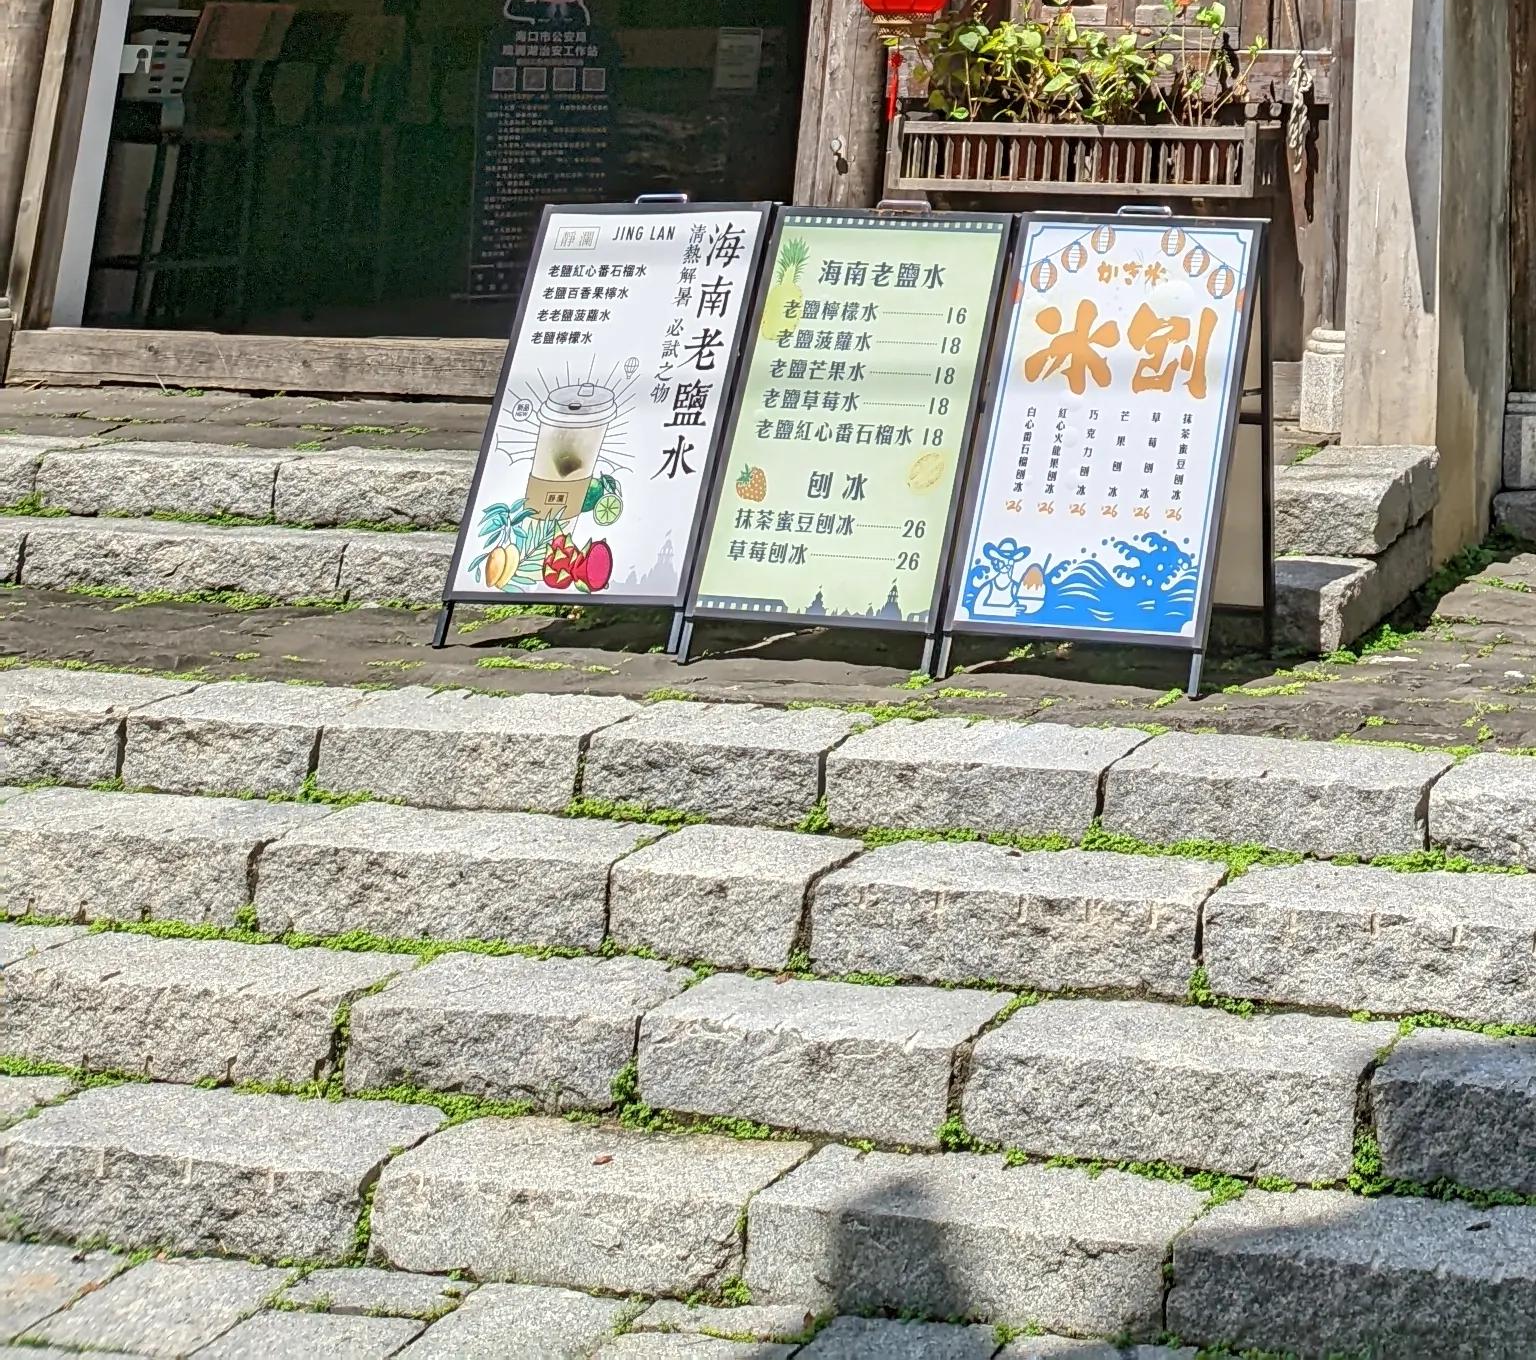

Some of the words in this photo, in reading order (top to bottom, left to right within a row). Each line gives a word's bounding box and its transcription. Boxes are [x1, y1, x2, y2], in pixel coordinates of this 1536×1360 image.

[612, 225, 644, 241] JING
[650, 225, 676, 241] LAN
[547, 264, 648, 278] 老鹽紅心番石榴水
[673, 223, 707, 308] 清熱解暑
[817, 258, 947, 290] 海南老鹽水
[542, 286, 630, 300] 老鹽百香果檸水
[536, 308, 612, 322] 老老鹽菠蘿水
[782, 298, 880, 323] 老鹽檸檬水
[947, 306, 969, 325] 16
[530, 330, 593, 345] 老鹽檸檬水
[649, 222, 746, 481] 海南老鹽水
[776, 328, 874, 352] 老鹽菠蘿水
[941, 336, 962, 355] 18
[650, 318, 685, 404] 必試之物
[768, 358, 867, 382] 老鹽芒果水
[934, 366, 956, 385] 18
[762, 388, 860, 412] 老鹽草莓水
[928, 396, 950, 415] 18
[755, 418, 915, 447] 老鹽紅心番石榴水
[923, 428, 944, 447] 18
[1076, 409, 1099, 496] 巧克力刨冰
[1107, 411, 1131, 498] 芒果刨冰
[1139, 412, 1161, 499] 草莓刨冰
[807, 470, 870, 501] 刨冰
[734, 507, 856, 537] 抹茶蜜豆刨冰
[902, 519, 927, 539] 26
[727, 539, 809, 566] 草莓刨冰
[896, 551, 921, 571] 26
